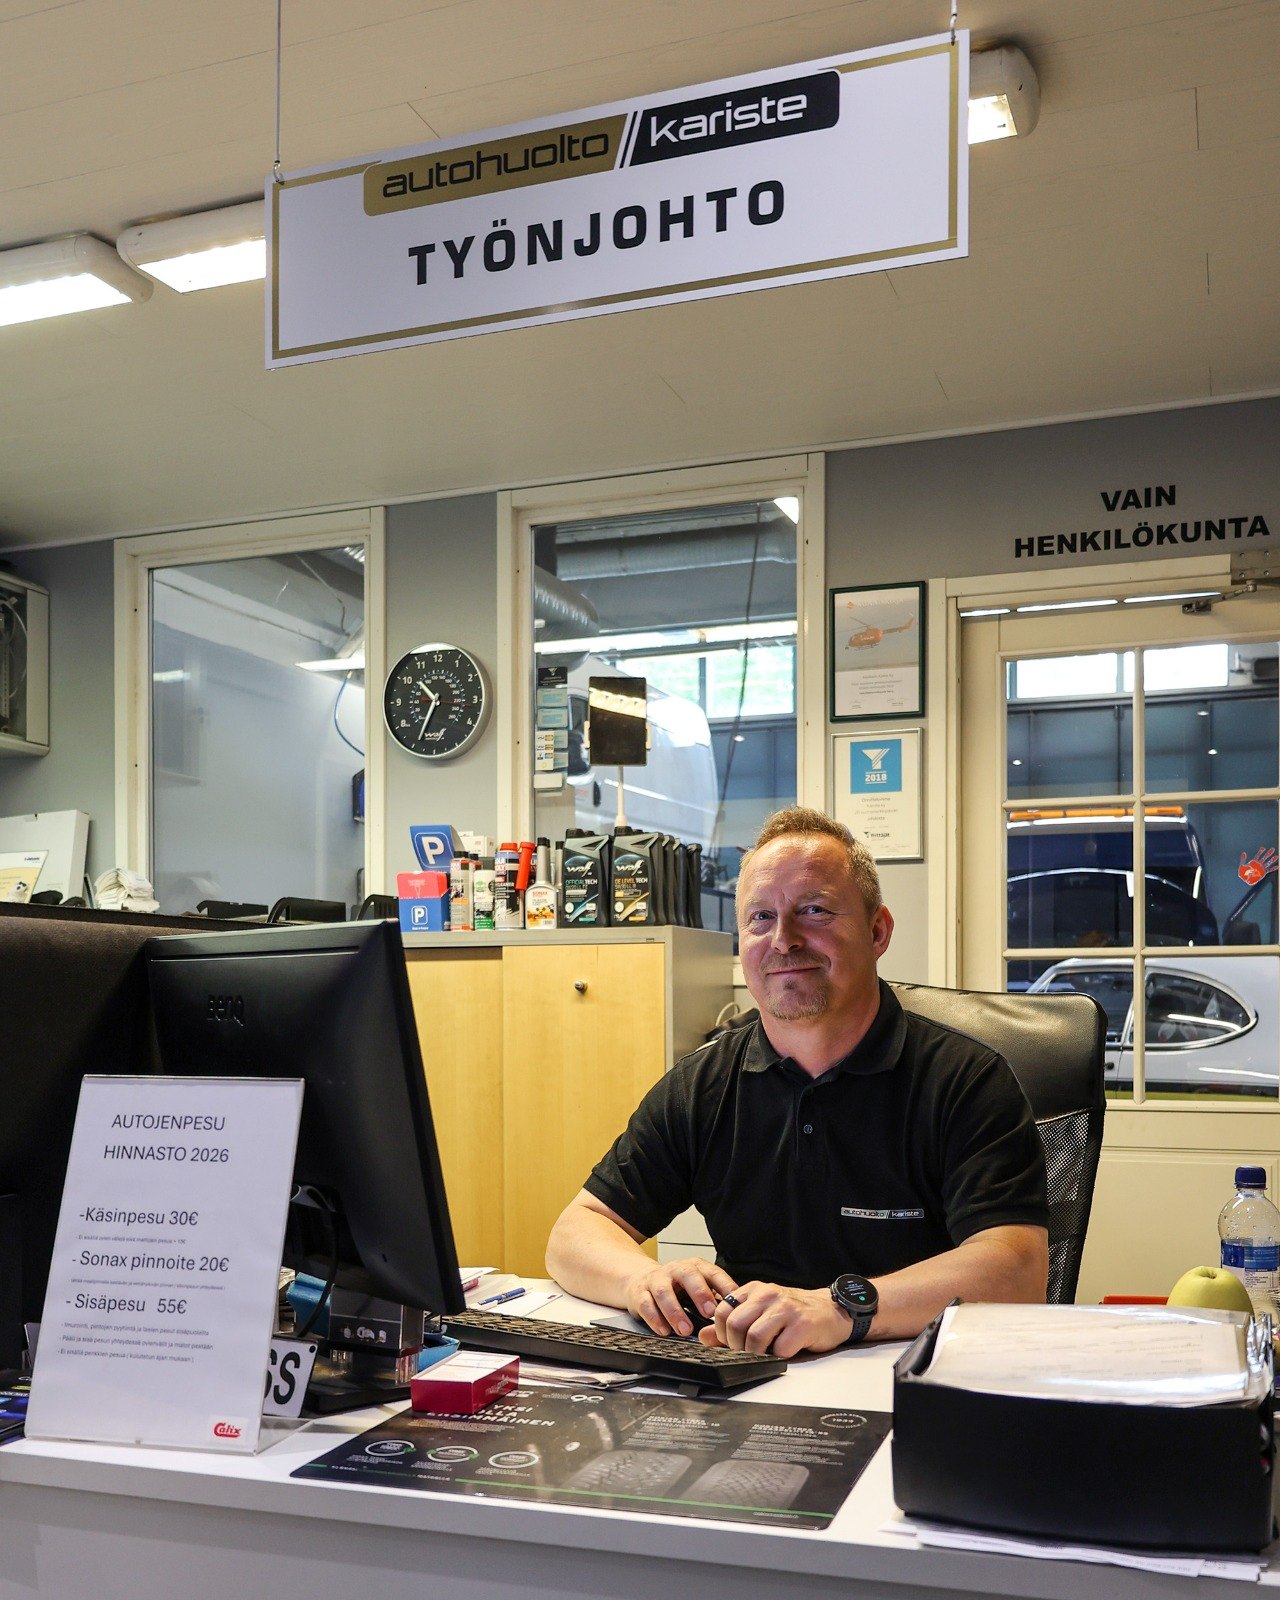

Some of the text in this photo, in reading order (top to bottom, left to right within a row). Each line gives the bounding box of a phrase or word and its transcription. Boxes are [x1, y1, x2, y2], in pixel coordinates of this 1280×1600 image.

[382, 92, 808, 199] autohuolto kariste
[409, 180, 785, 286] TYÖNJOHTO
[1101, 485, 1176, 512] VAIN
[1015, 515, 1270, 558] HENKILÖKUNTA
[402, 676, 413, 684] 10
[468, 674, 473, 682] 2
[396, 698, 402, 706] 9
[472, 696, 478, 704] 3
[466, 718, 472, 726] 4
[865, 774, 887, 782] 2018
[422, 837, 444, 864] P
[414, 908, 425, 923] P
[112, 1114, 225, 1131] AUTOJENPESU
[104, 1145, 229, 1162] HINNASTO 2026
[169, 1211, 199, 1226] 30€
[80, 1251, 127, 1268] Sonax
[131, 1254, 195, 1271] pinnoite
[200, 1257, 229, 1272] 20€
[75, 1294, 146, 1313] Sisäpesu
[157, 1298, 187, 1315] 55€
[493, 1404, 533, 1413] YKSI
[214, 1423, 241, 1438] Calix
